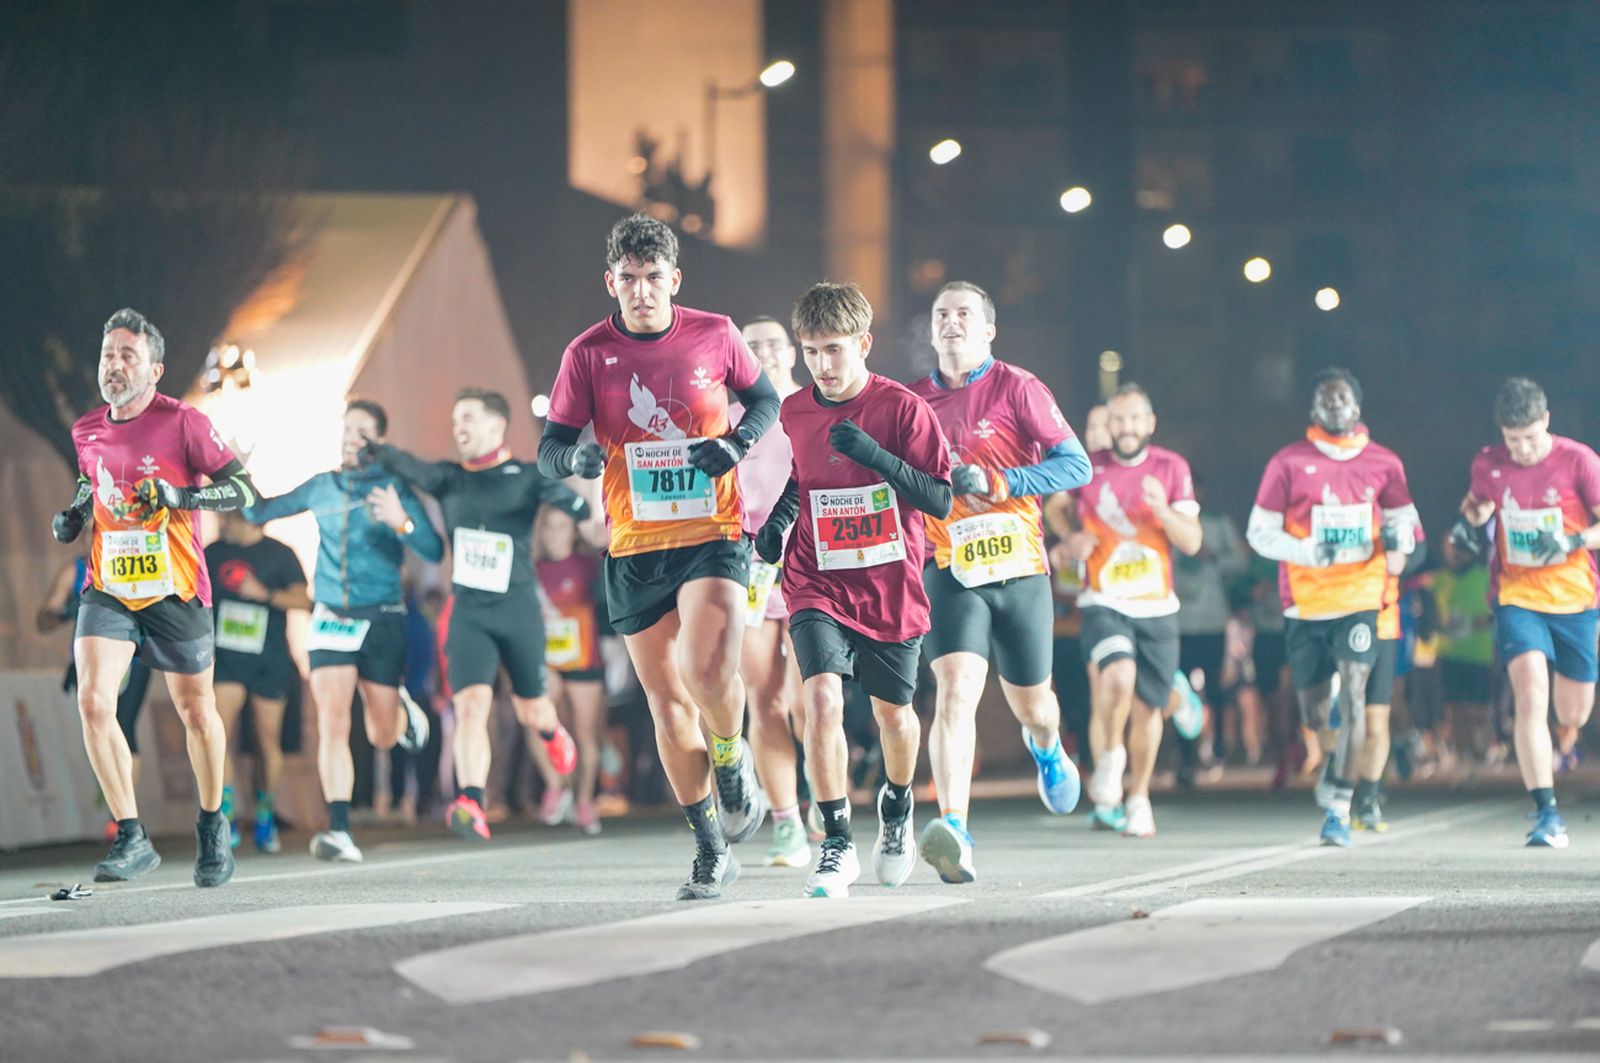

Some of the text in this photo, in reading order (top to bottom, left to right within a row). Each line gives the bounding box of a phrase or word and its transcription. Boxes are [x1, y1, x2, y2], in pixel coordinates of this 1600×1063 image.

[648, 414, 668, 432] 43
[636, 458, 683, 468] SAN ANTÓN
[645, 450, 670, 458] NOCHE
[648, 468, 696, 493] 7817
[830, 497, 853, 506] NOCHE
[822, 506, 866, 516] SAN ANTÓN
[832, 514, 882, 541] 2547
[964, 535, 1012, 562] 8469
[111, 554, 158, 576] 13713
